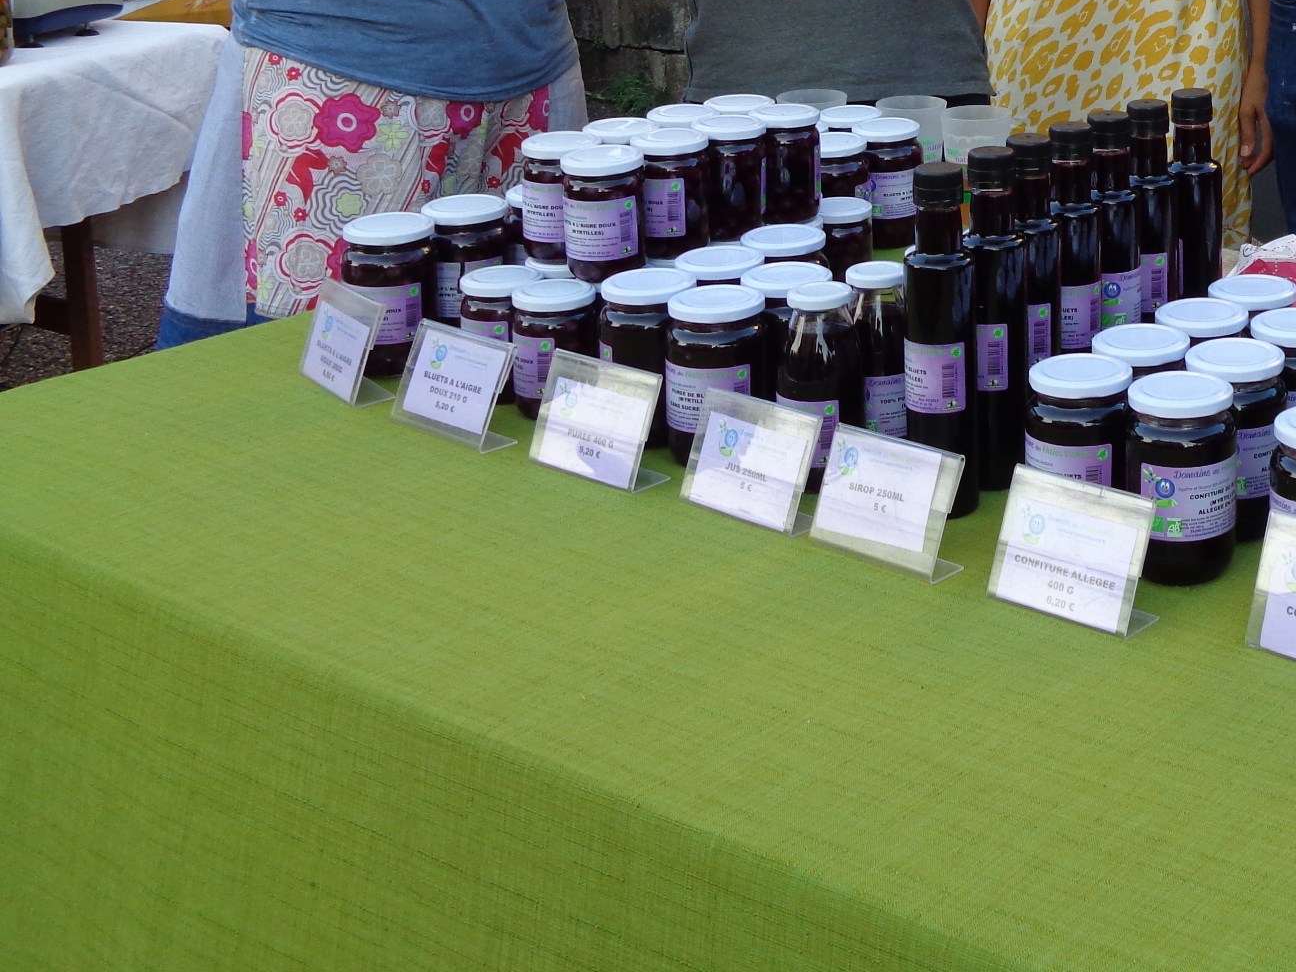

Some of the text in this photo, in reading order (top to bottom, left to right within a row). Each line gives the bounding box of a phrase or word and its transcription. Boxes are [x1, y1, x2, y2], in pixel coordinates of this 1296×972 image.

[424, 370, 482, 394] BLUETS A L'AIGRE
[429, 386, 448, 397] DOUX
[596, 450, 601, 459] €
[1254, 450, 1274, 459] CONFIT
[725, 462, 767, 482] JUS 250ML
[1173, 469, 1211, 479] Domaine
[740, 481, 745, 490] 5
[849, 482, 905, 502] SIROP 250ML
[1190, 488, 1224, 499] CONFITURE
[873, 502, 887, 513] 5 €
[1014, 553, 1116, 591] CONFITURE ALLEGEE
[1047, 579, 1074, 595] 400 G
[1046, 596, 1075, 612] 6,20 €
